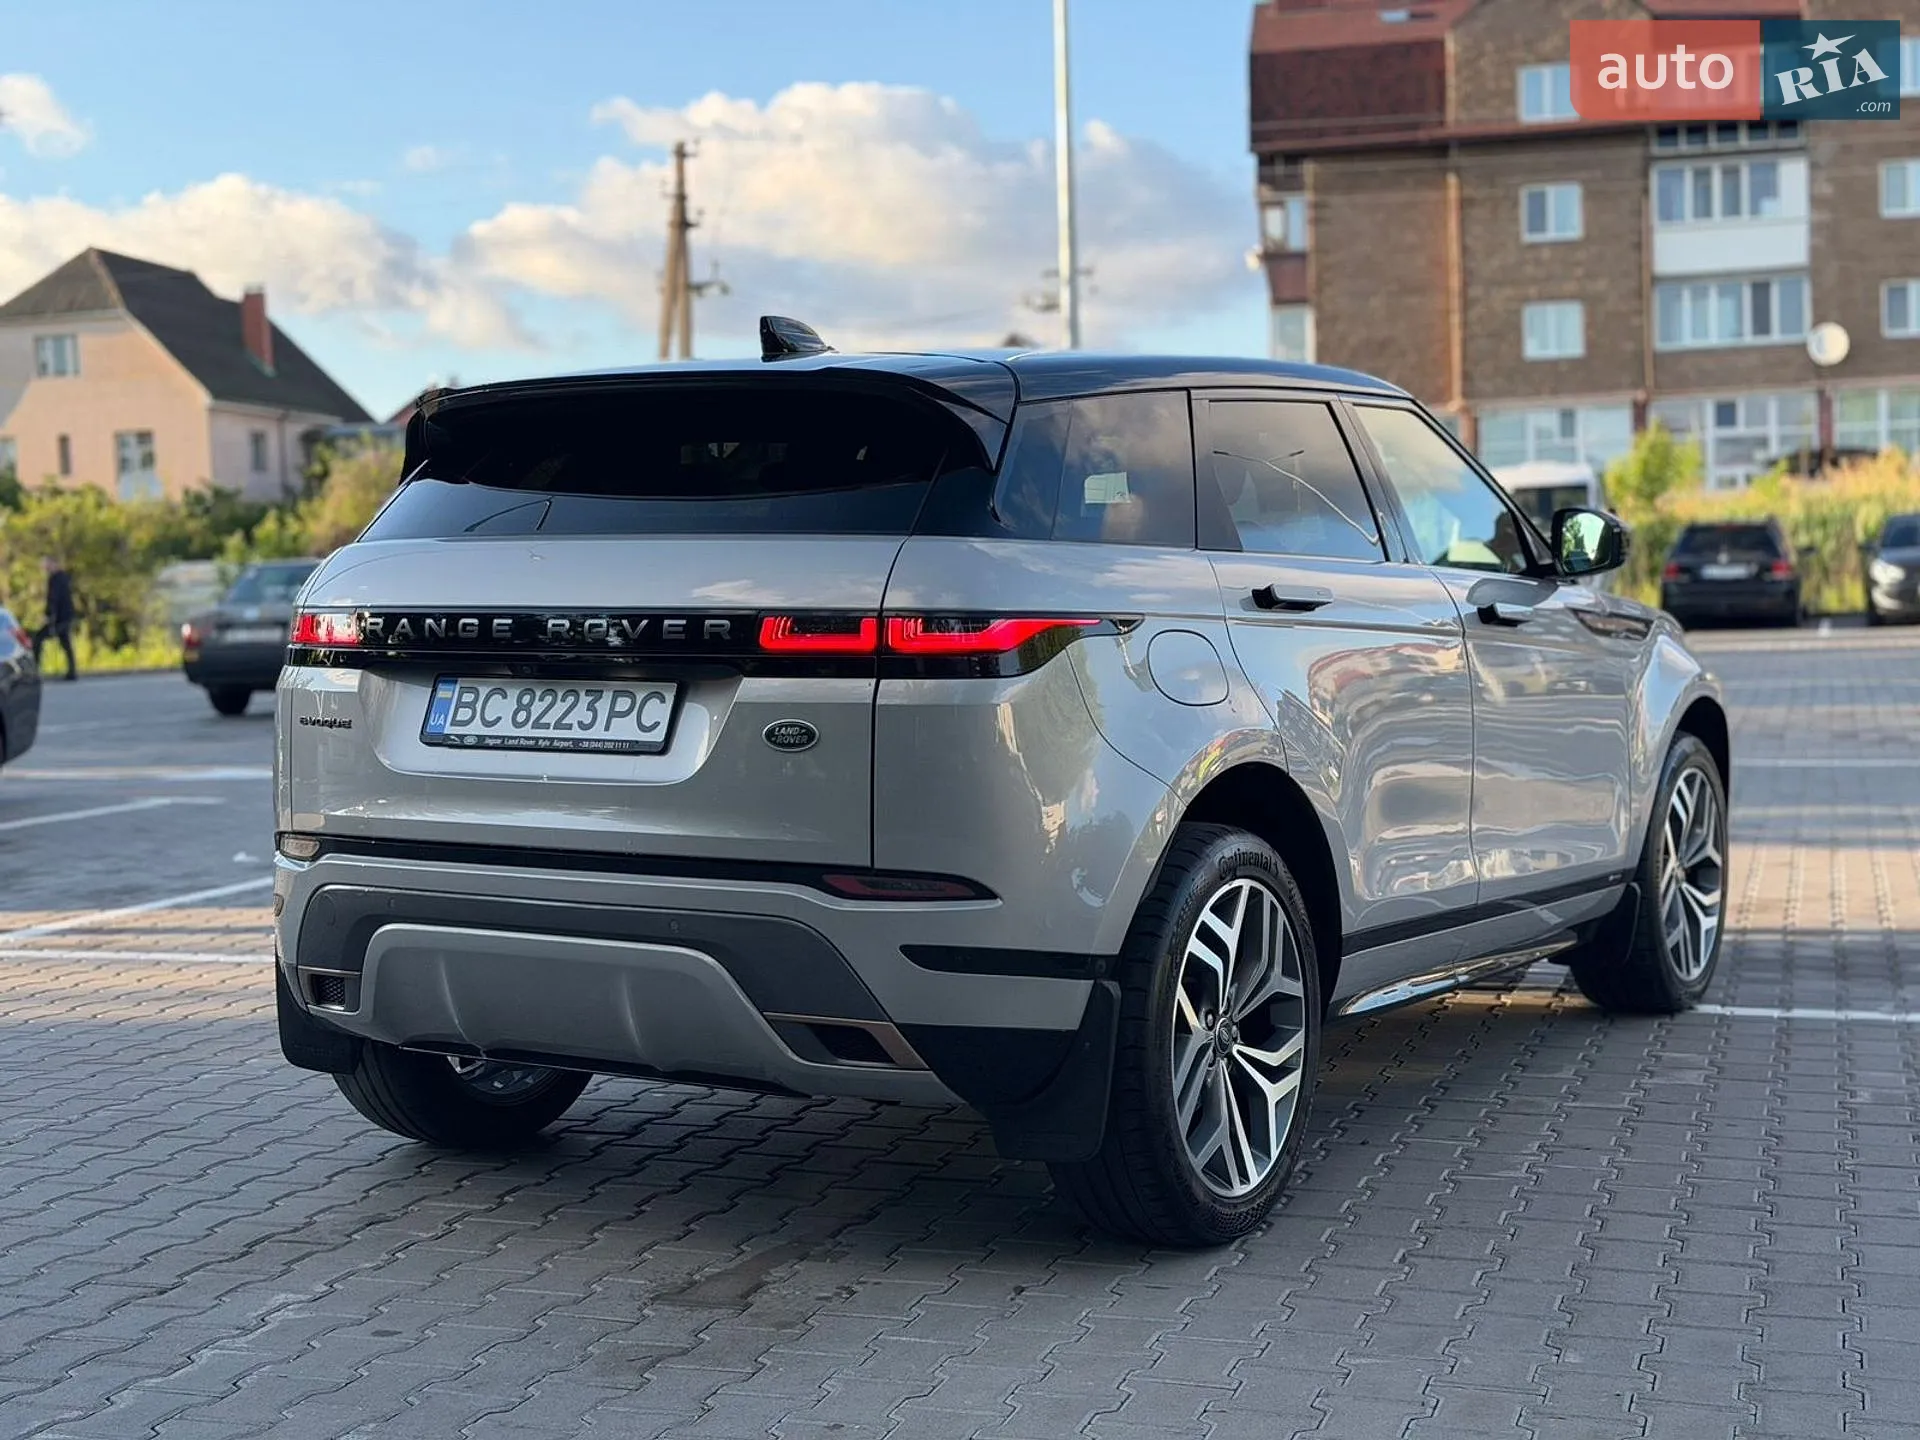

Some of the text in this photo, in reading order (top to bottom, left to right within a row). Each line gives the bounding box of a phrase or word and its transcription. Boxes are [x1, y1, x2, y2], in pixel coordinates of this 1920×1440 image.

[366, 617, 731, 640] RANGE ROVER
[430, 712, 444, 726] UA
[450, 686, 666, 733] BC 8223 PC
